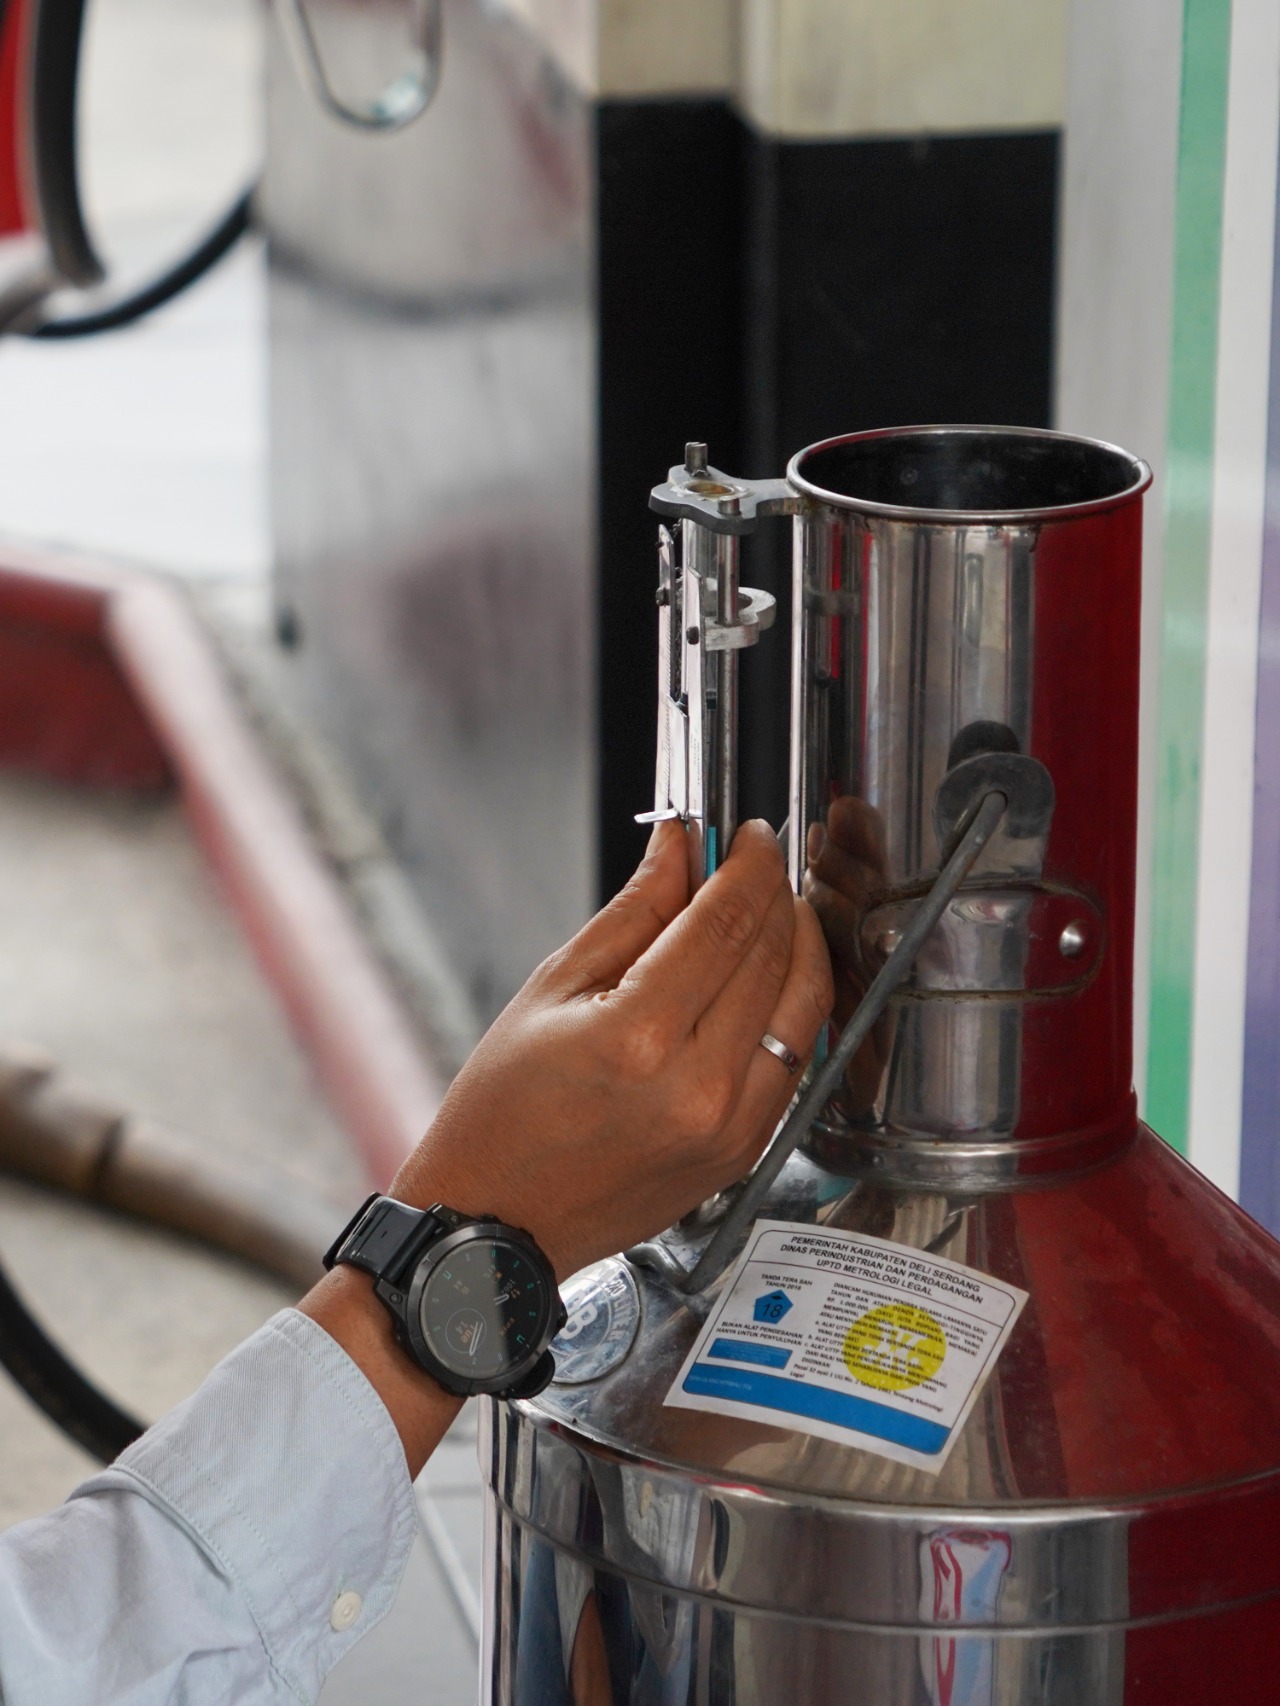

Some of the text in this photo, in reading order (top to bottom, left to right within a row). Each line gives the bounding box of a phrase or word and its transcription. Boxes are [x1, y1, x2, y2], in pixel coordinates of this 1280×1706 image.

[781, 1244, 983, 1304] DINAS PERINDUSTRIAN DAN PERDAGANGAN
[791, 1236, 980, 1292] PEMERINTAH KABUPATEN DELI SERDANG
[817, 1259, 933, 1296] UPTD METROLOGI LEGAL
[766, 1281, 786, 1289] TAHUN
[763, 1303, 782, 1318] 18
